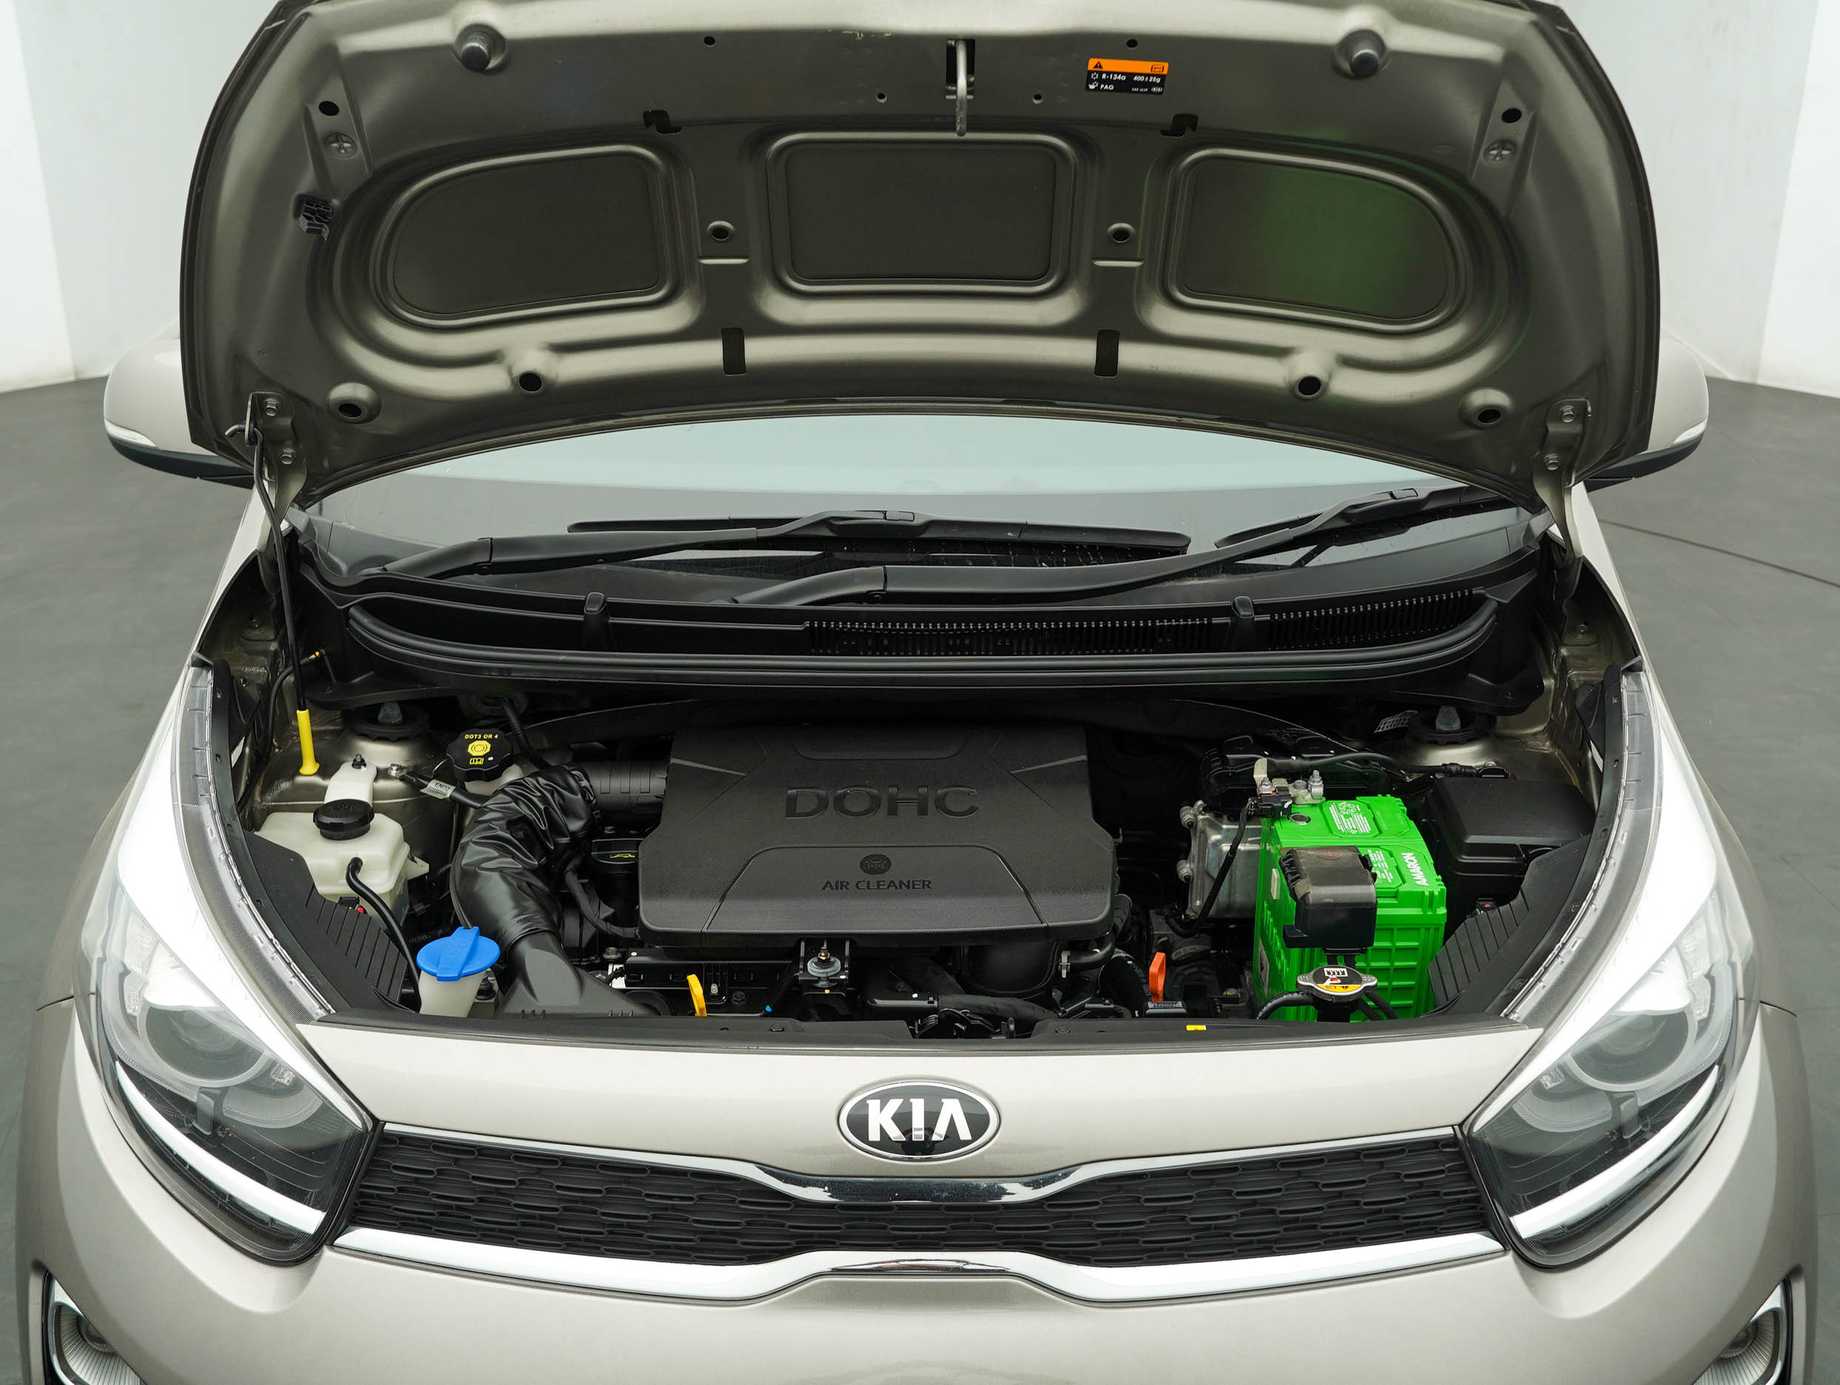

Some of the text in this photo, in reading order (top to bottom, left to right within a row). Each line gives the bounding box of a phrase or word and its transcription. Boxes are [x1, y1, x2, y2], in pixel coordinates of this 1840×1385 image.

[784, 784, 980, 819] DOHC
[822, 879, 933, 891] AIR CLEANER
[1401, 852, 1430, 887] AMARON
[866, 1097, 973, 1142] KIA
